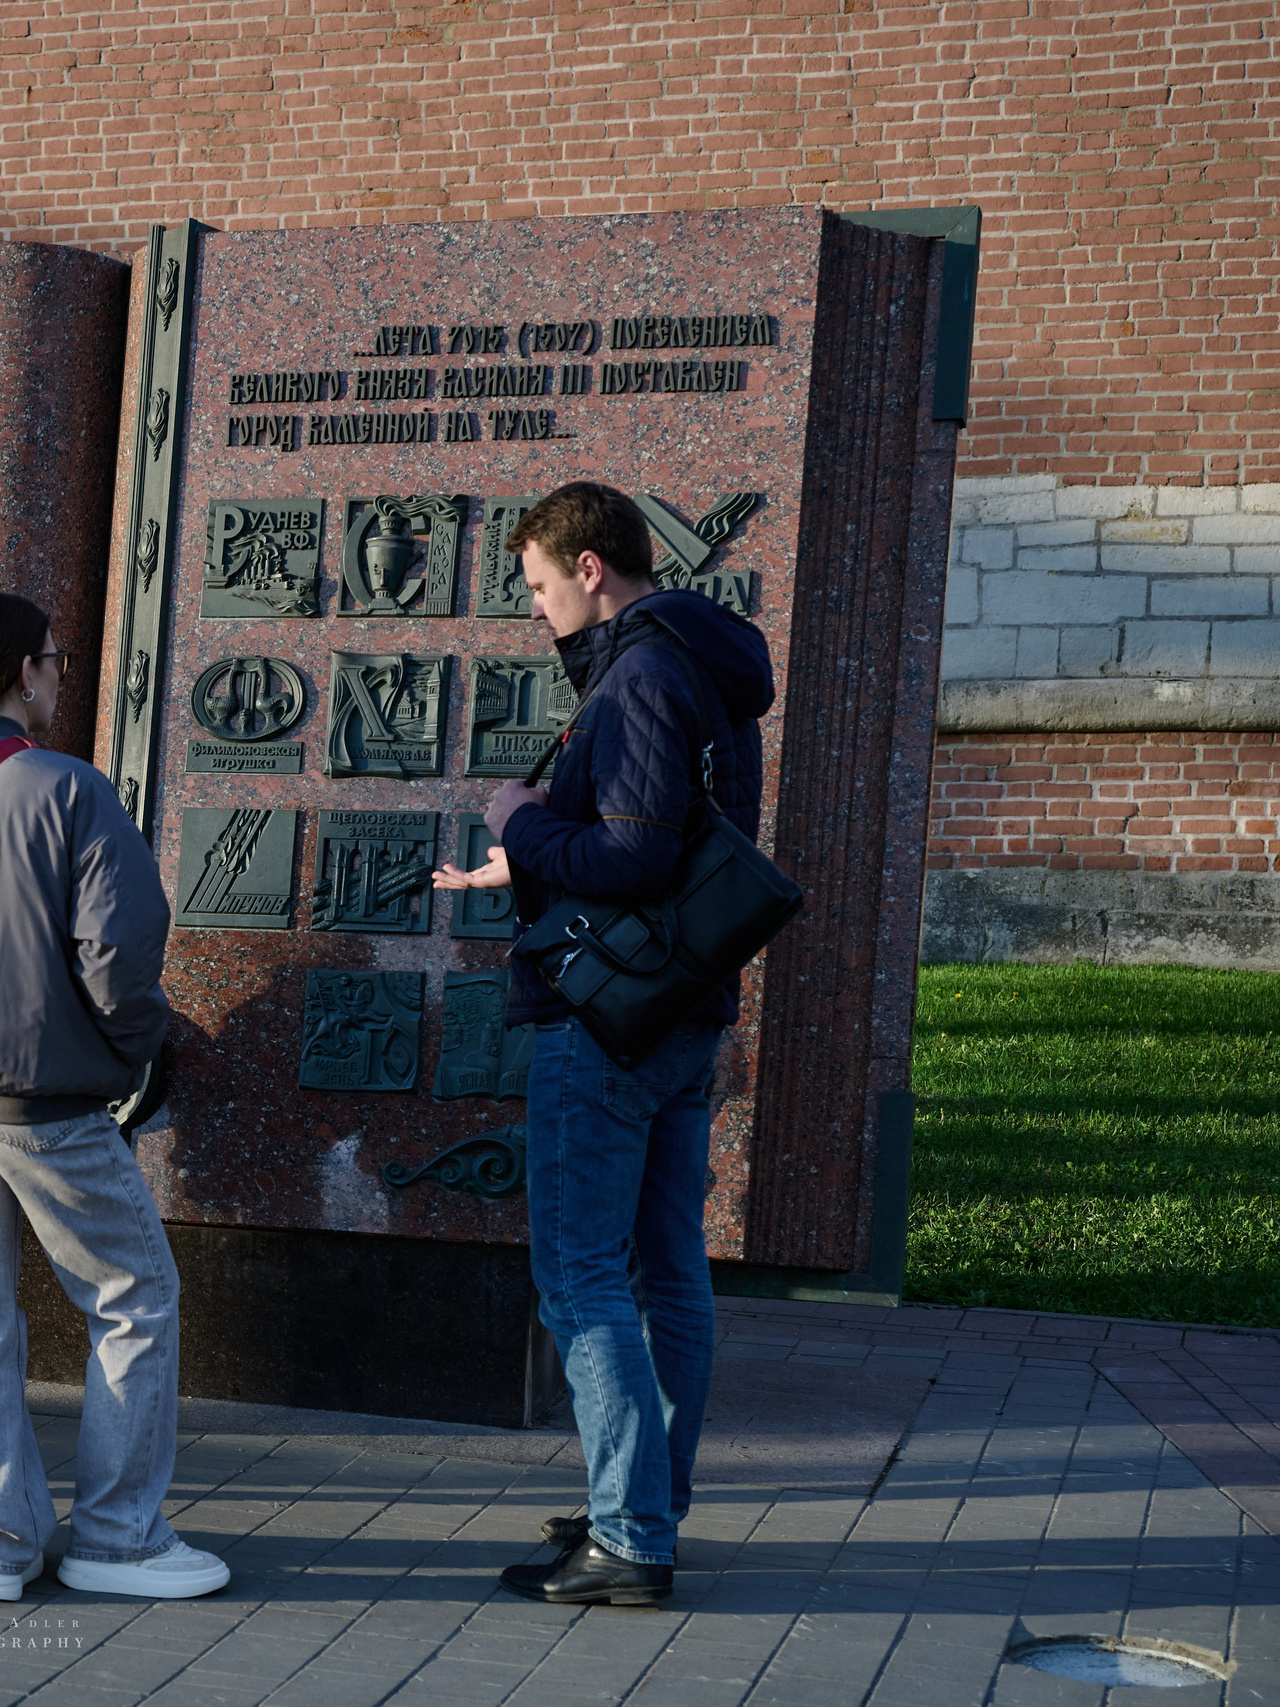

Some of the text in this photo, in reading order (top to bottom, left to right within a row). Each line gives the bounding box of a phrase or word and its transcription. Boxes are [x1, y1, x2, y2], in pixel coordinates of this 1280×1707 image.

[447, 325, 504, 354] 7015
[518, 319, 594, 358] (1507)
[610, 314, 771, 350] ПОВЕЛЕНИЕМ
[228, 370, 340, 405] ВЕЛИКОГО
[354, 366, 427, 400] КНЯЗЯ
[440, 364, 546, 399] ВАСИЛИЯ
[599, 360, 741, 395] ПОСТАВЛЕН
[226, 413, 295, 453] ГОРОД
[307, 407, 431, 446] КАМЕННОЙ
[444, 411, 473, 443] НА
[430, 523, 452, 595] САМОВАР
[211, 758, 277, 771] игрушка
[329, 812, 427, 826] ЩЕГЛОВСКАЯ
[348, 826, 405, 838] ЗАСЕКА
